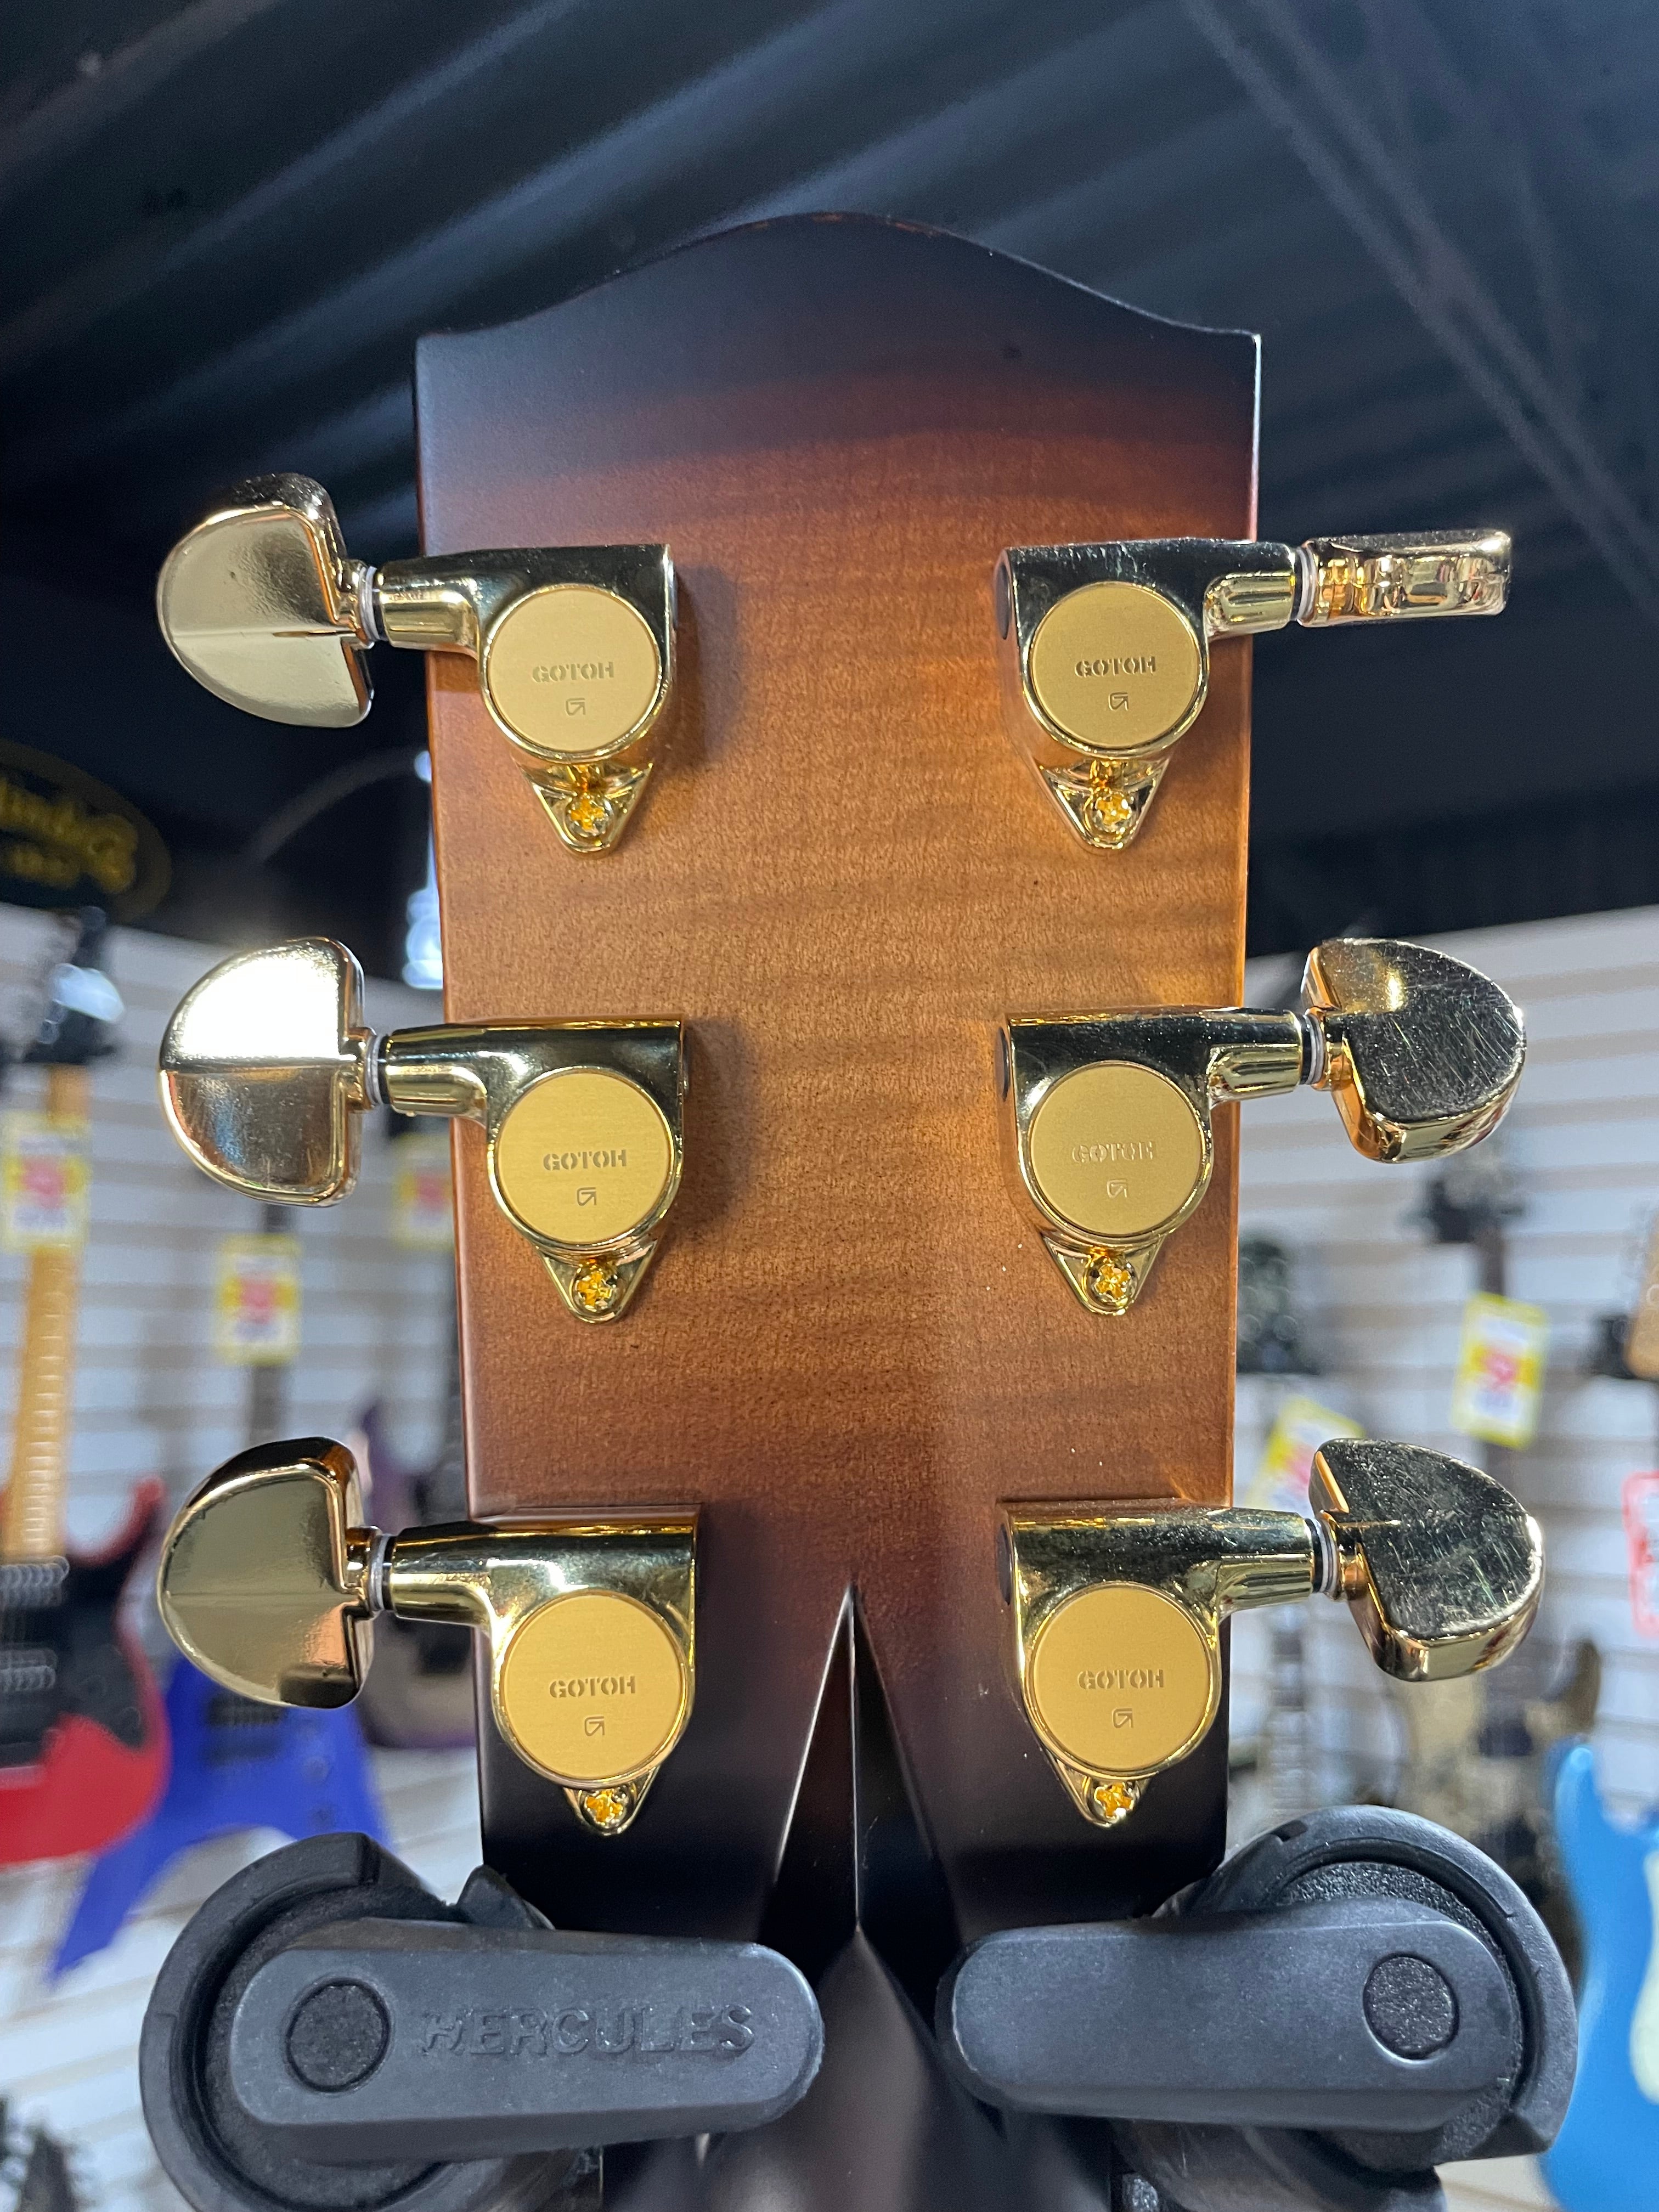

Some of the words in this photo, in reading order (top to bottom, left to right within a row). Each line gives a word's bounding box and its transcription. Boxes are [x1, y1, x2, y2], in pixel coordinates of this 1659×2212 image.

[532, 662, 614, 684] GOTOH
[1074, 656, 1156, 678] GOTOH
[543, 1149, 627, 1171] GOTOH
[1072, 1141, 1156, 1163] GOTOH
[549, 1675, 636, 1699] GOTOH
[1077, 1668, 1165, 1690] GOTOH
[421, 2005, 755, 2055] HERCULES
